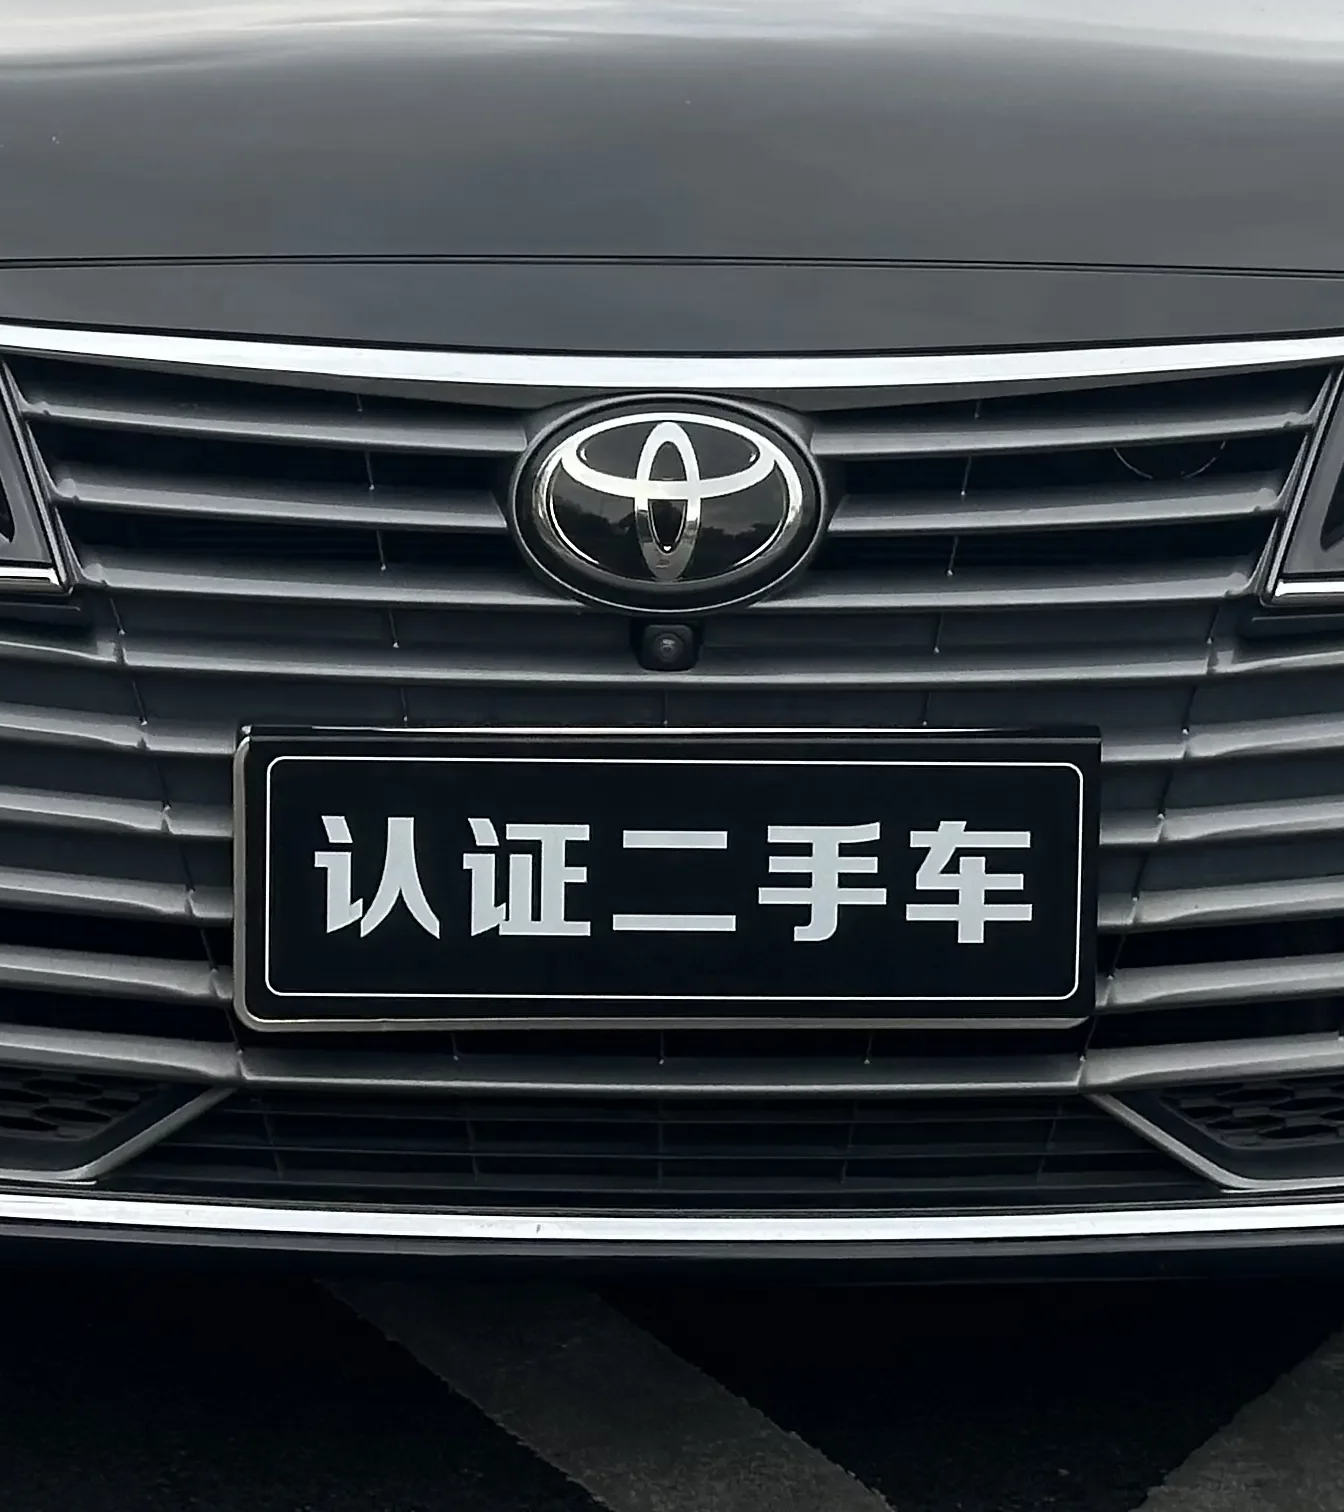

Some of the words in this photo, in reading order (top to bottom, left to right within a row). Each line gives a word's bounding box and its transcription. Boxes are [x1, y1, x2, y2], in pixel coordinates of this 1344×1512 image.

[315, 816, 1032, 943] 认证二手车
